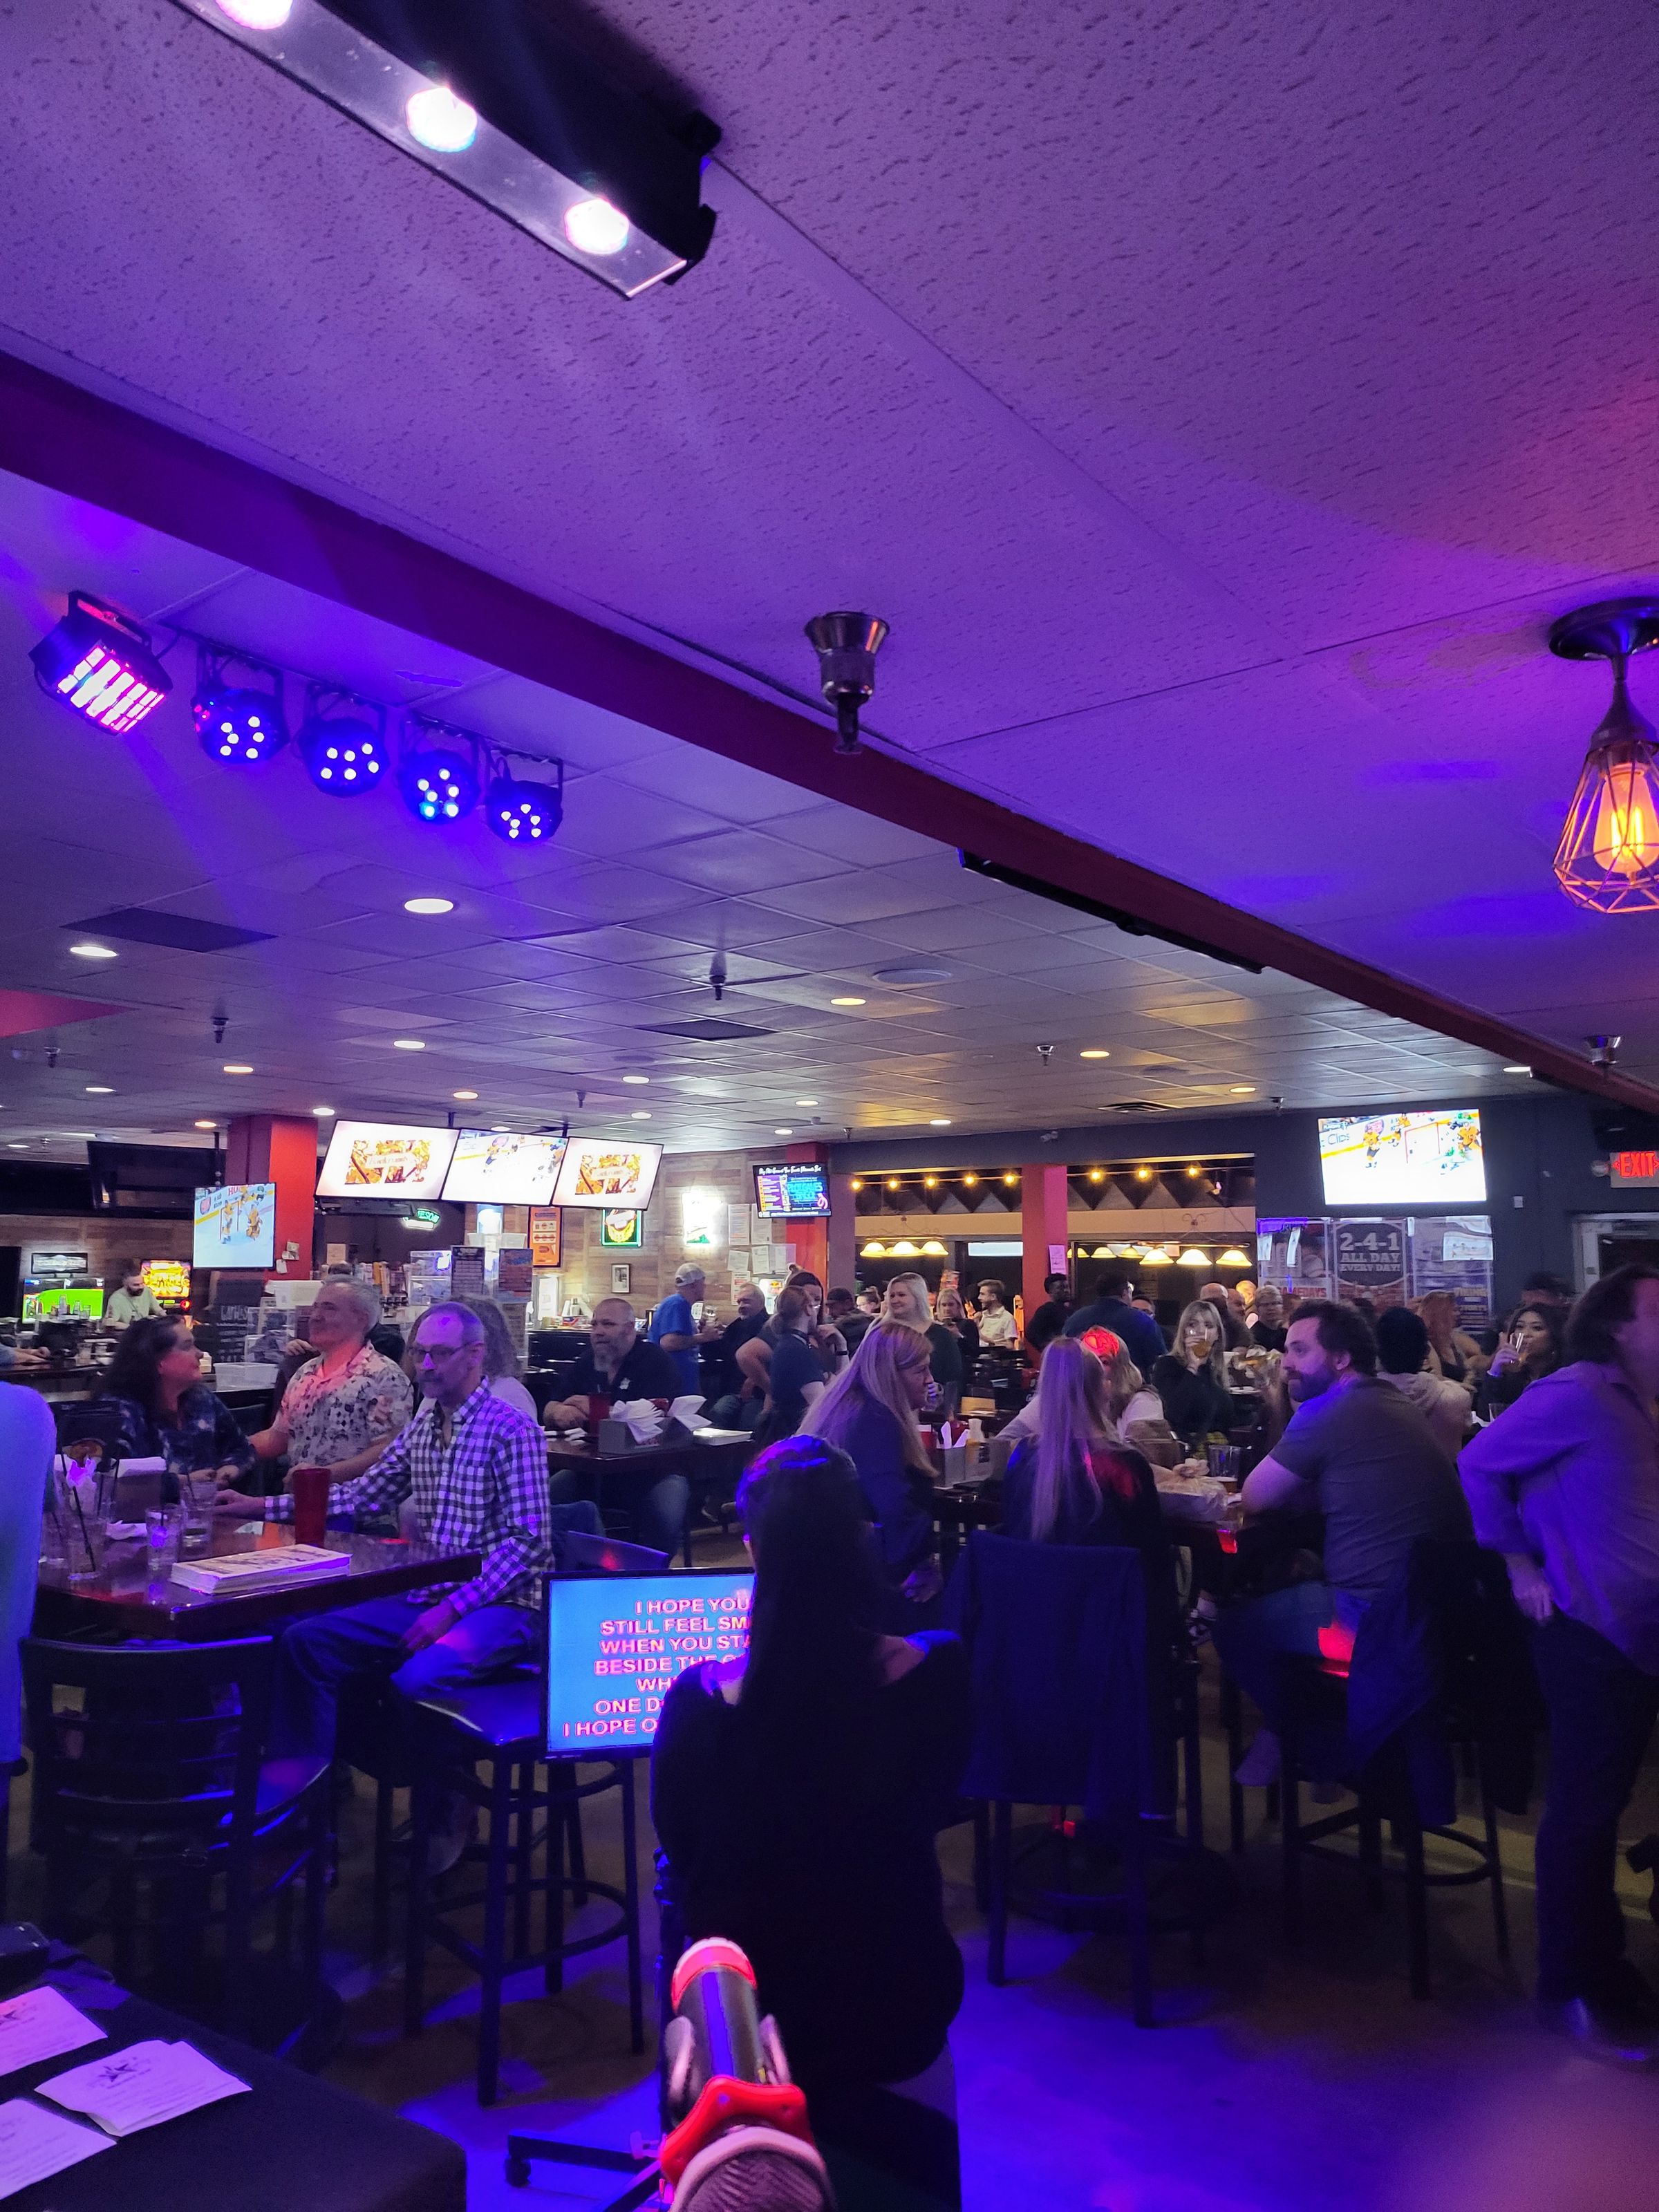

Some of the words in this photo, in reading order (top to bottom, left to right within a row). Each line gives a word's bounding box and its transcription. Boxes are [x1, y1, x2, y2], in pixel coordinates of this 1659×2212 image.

[1620, 1152, 1655, 1178] EXIT
[1340, 1232, 1400, 1251] 2-4-1
[1341, 1253, 1367, 1263] ALL
[1370, 1253, 1400, 1263] DAY
[635, 1600, 643, 1615] I
[646, 1598, 704, 1615] HOPE
[707, 1596, 751, 1613] YOU
[600, 1619, 660, 1635] STILL
[663, 1616, 715, 1632] FEEL
[718, 1615, 751, 1630] SM
[599, 1637, 665, 1655] WHEN
[668, 1635, 713, 1652] YOU
[594, 1656, 673, 1676] BESIDE
[636, 1676, 677, 1692] WH
[593, 1698, 642, 1716] ONE
[563, 1722, 570, 1737] I
[575, 1718, 637, 1736] HOPE
